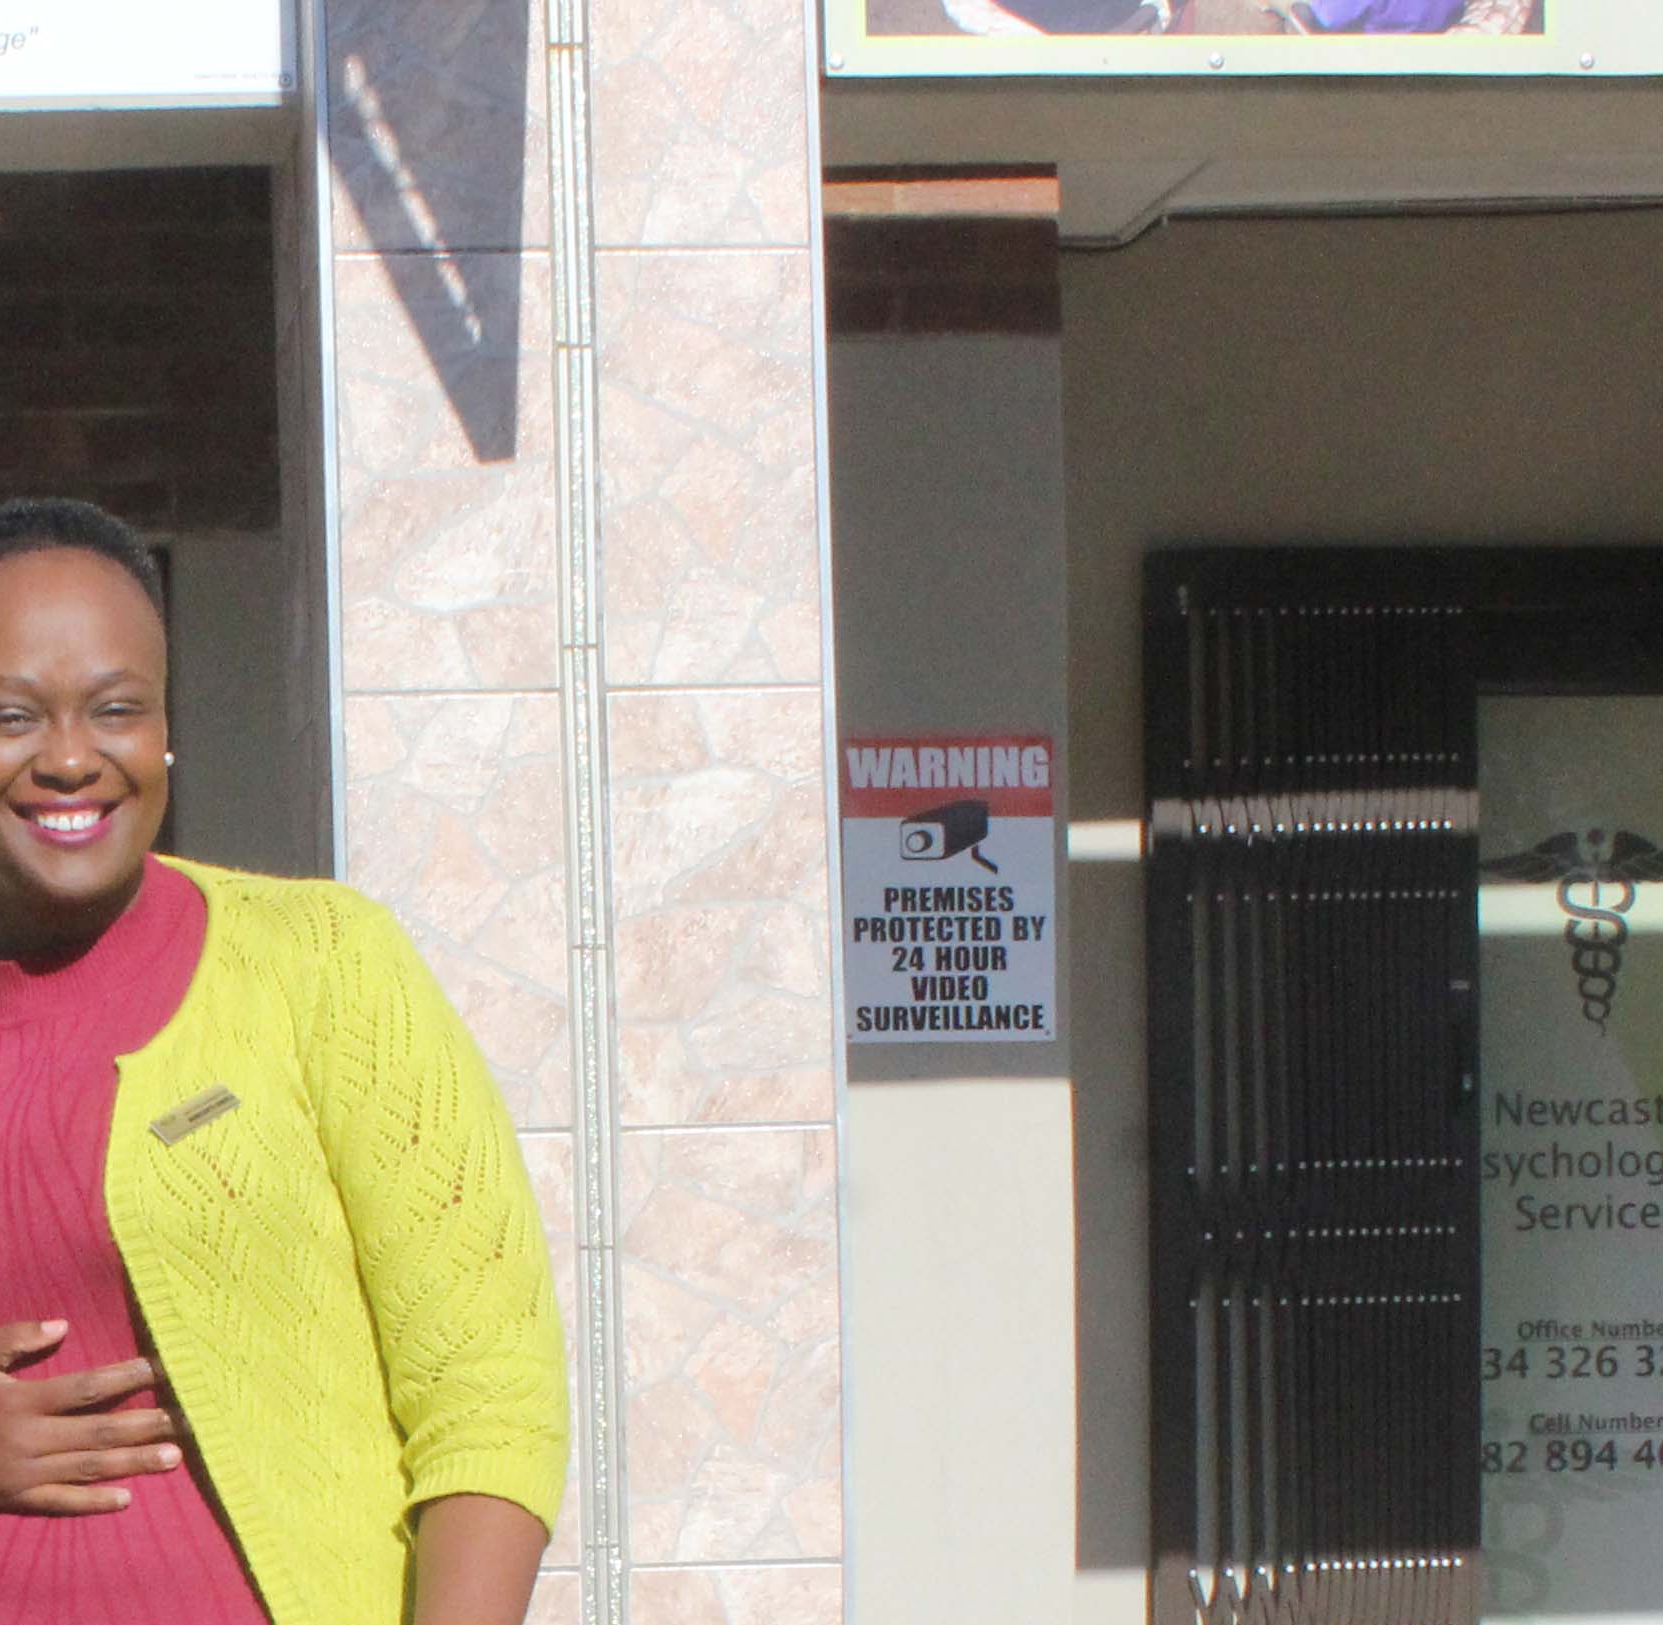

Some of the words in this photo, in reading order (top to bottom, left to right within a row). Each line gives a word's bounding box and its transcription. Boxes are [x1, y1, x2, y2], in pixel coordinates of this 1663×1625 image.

[846, 745, 1050, 789] WARNING
[884, 886, 1015, 912] PREMISES
[853, 916, 1002, 943] PROTECTED
[1012, 915, 1047, 941] BY
[891, 947, 925, 972] 24
[935, 946, 1008, 971] HOUR
[910, 975, 988, 1001] VIDEO
[856, 1005, 1044, 1032] SURVEILLANCE
[1517, 1320, 1583, 1341] Office
[1546, 1345, 1619, 1379] 326
[1634, 1344, 1663, 1378] 3
[1529, 1412, 1571, 1434] Cell
[1545, 1439, 1618, 1472] 894
